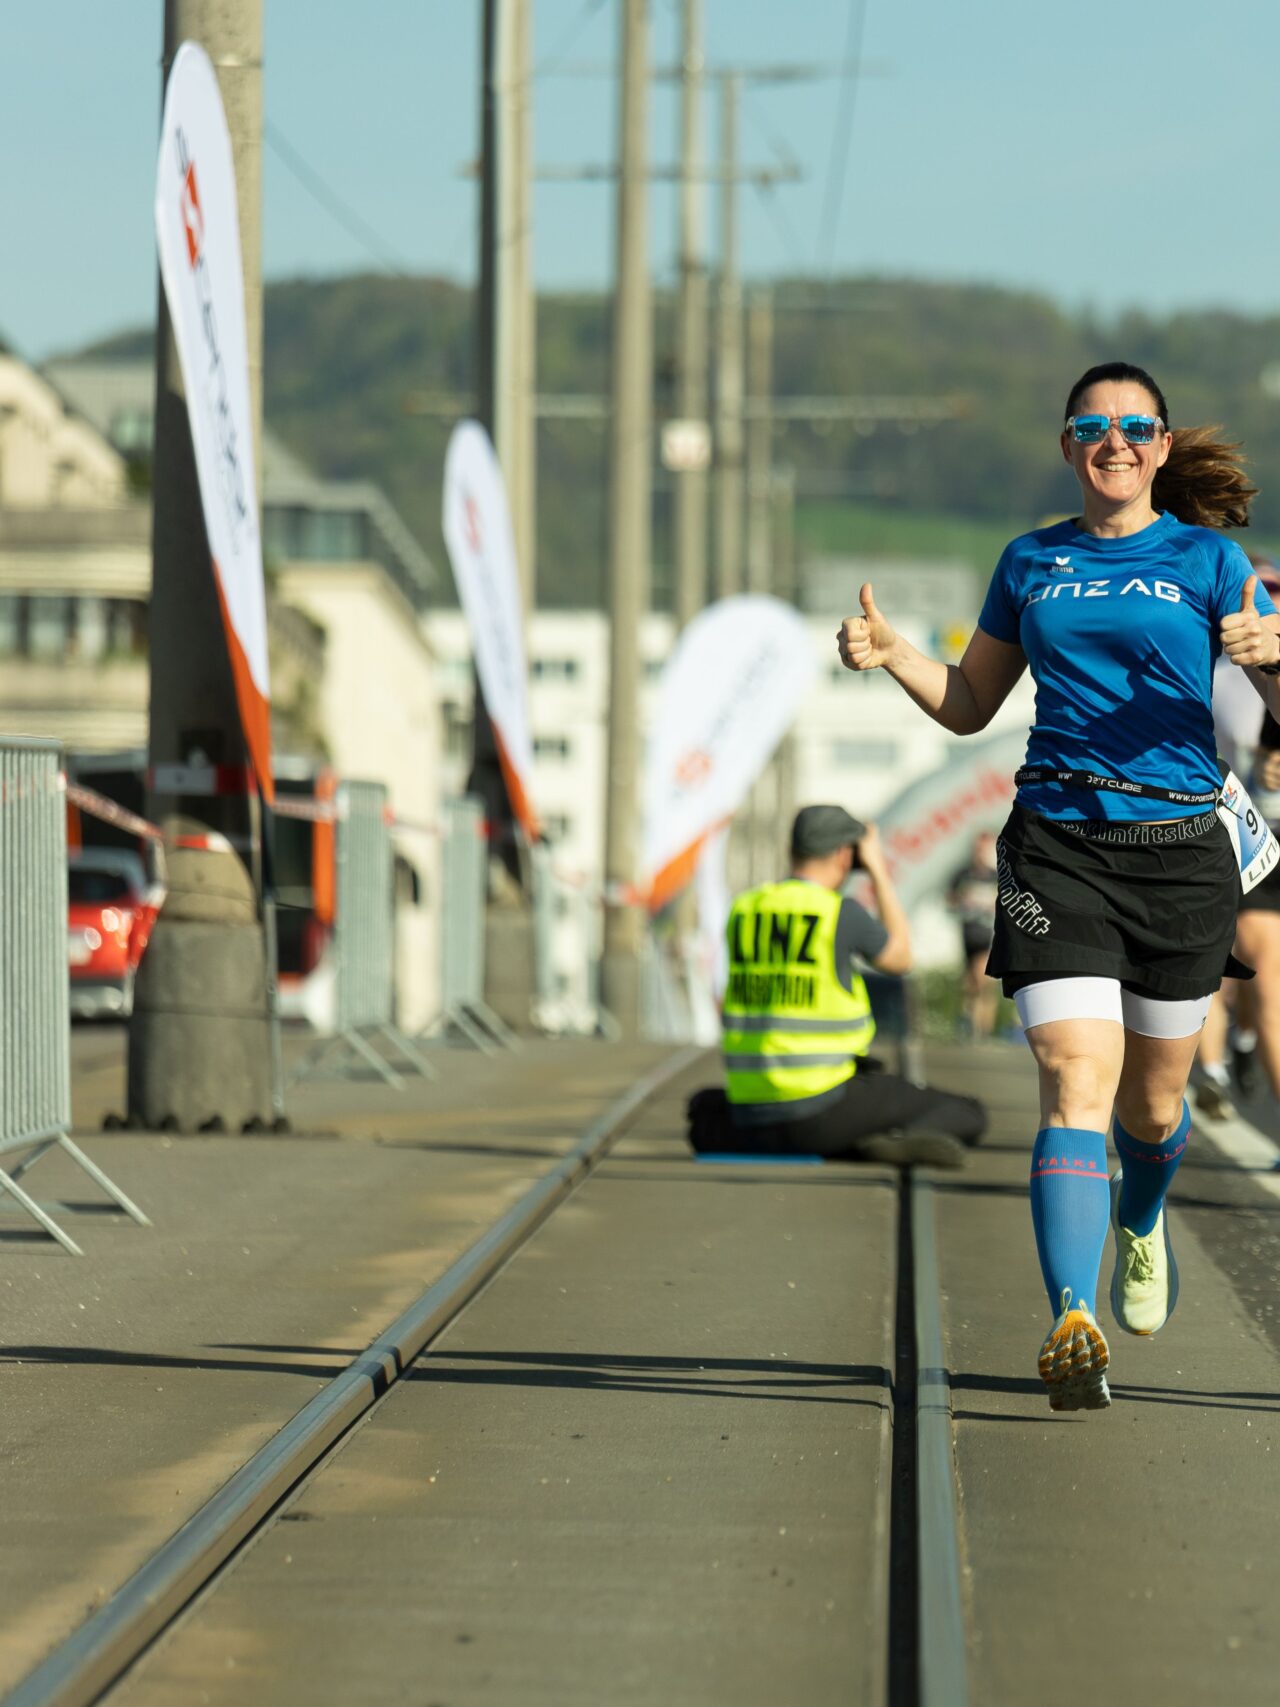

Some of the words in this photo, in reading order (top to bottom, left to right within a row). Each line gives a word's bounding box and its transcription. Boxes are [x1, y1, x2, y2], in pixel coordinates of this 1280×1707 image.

[1119, 578, 1181, 604] AG
[1249, 842, 1279, 882] LIN
[734, 913, 821, 964] LINZ
